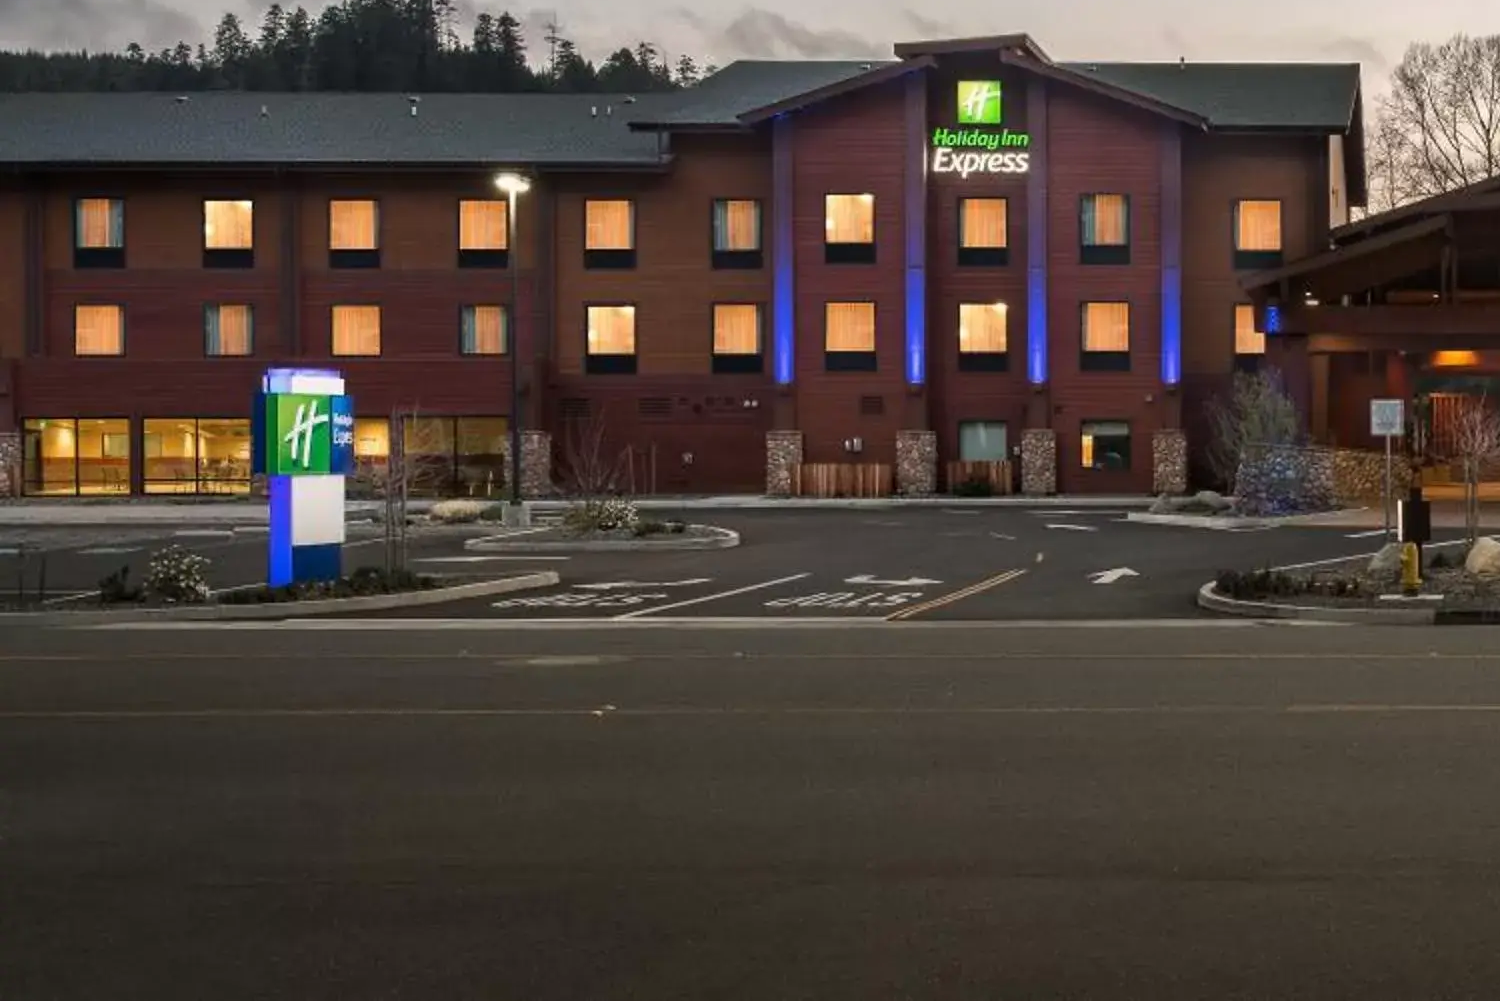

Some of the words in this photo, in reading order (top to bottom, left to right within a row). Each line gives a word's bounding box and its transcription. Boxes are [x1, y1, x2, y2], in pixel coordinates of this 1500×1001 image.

[933, 128, 999, 150] Holiday
[1001, 128, 1029, 146] Inn
[933, 147, 1030, 179] Express
